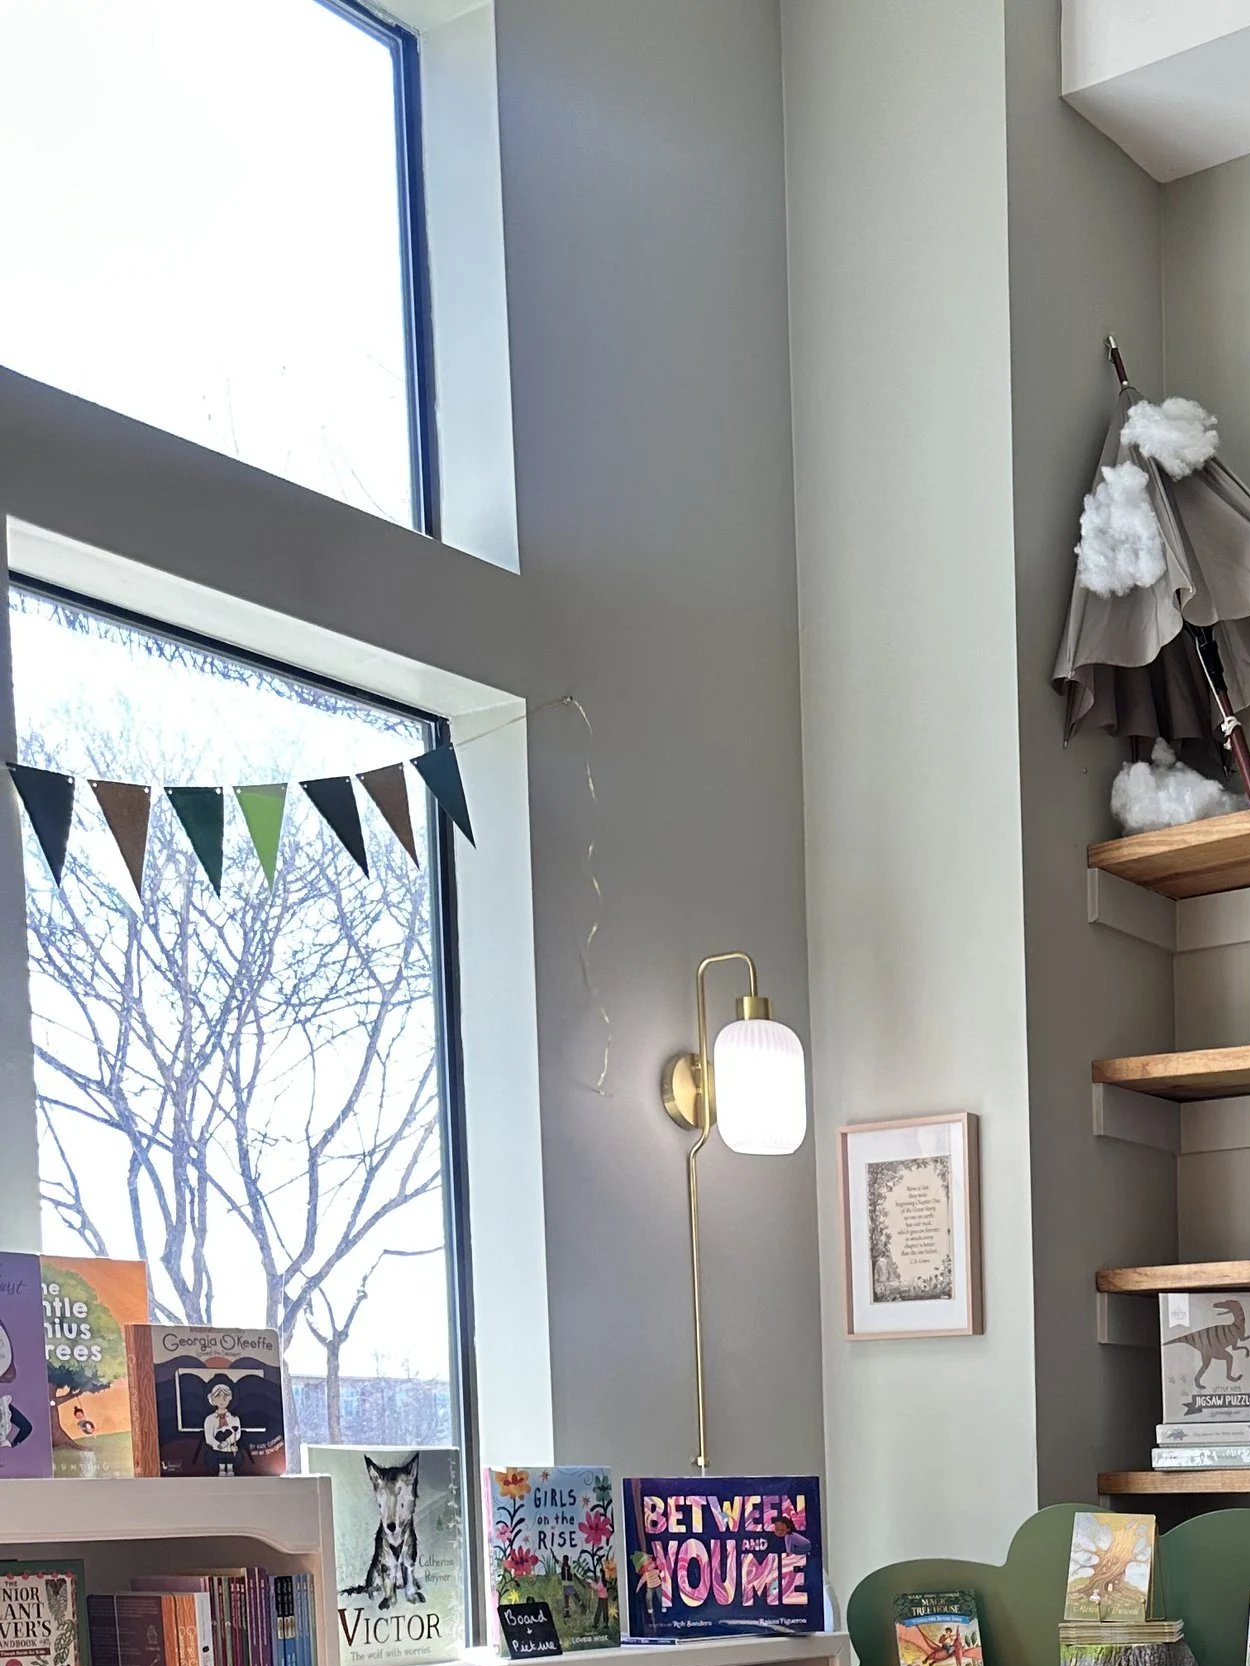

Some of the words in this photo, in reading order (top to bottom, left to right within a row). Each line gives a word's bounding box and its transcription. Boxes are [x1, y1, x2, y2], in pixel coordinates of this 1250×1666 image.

[162, 1334, 218, 1352] Georgia
[1195, 1396, 1223, 1407] JIGSAW
[534, 1487, 577, 1508] GIRLS
[537, 1516, 550, 1526] on
[553, 1513, 575, 1526] the
[643, 1495, 807, 1534] BETWEEN
[741, 1538, 768, 1551] AND
[651, 1539, 736, 1608] YOU
[742, 1552, 808, 1606] ME
[504, 1609, 547, 1624] Board
[338, 1608, 442, 1646] VICTOR
[512, 1638, 557, 1653] Picture
[351, 1649, 365, 1661] The
[368, 1649, 384, 1659] wolf
[385, 1649, 400, 1658] with
[403, 1647, 431, 1657] worries
